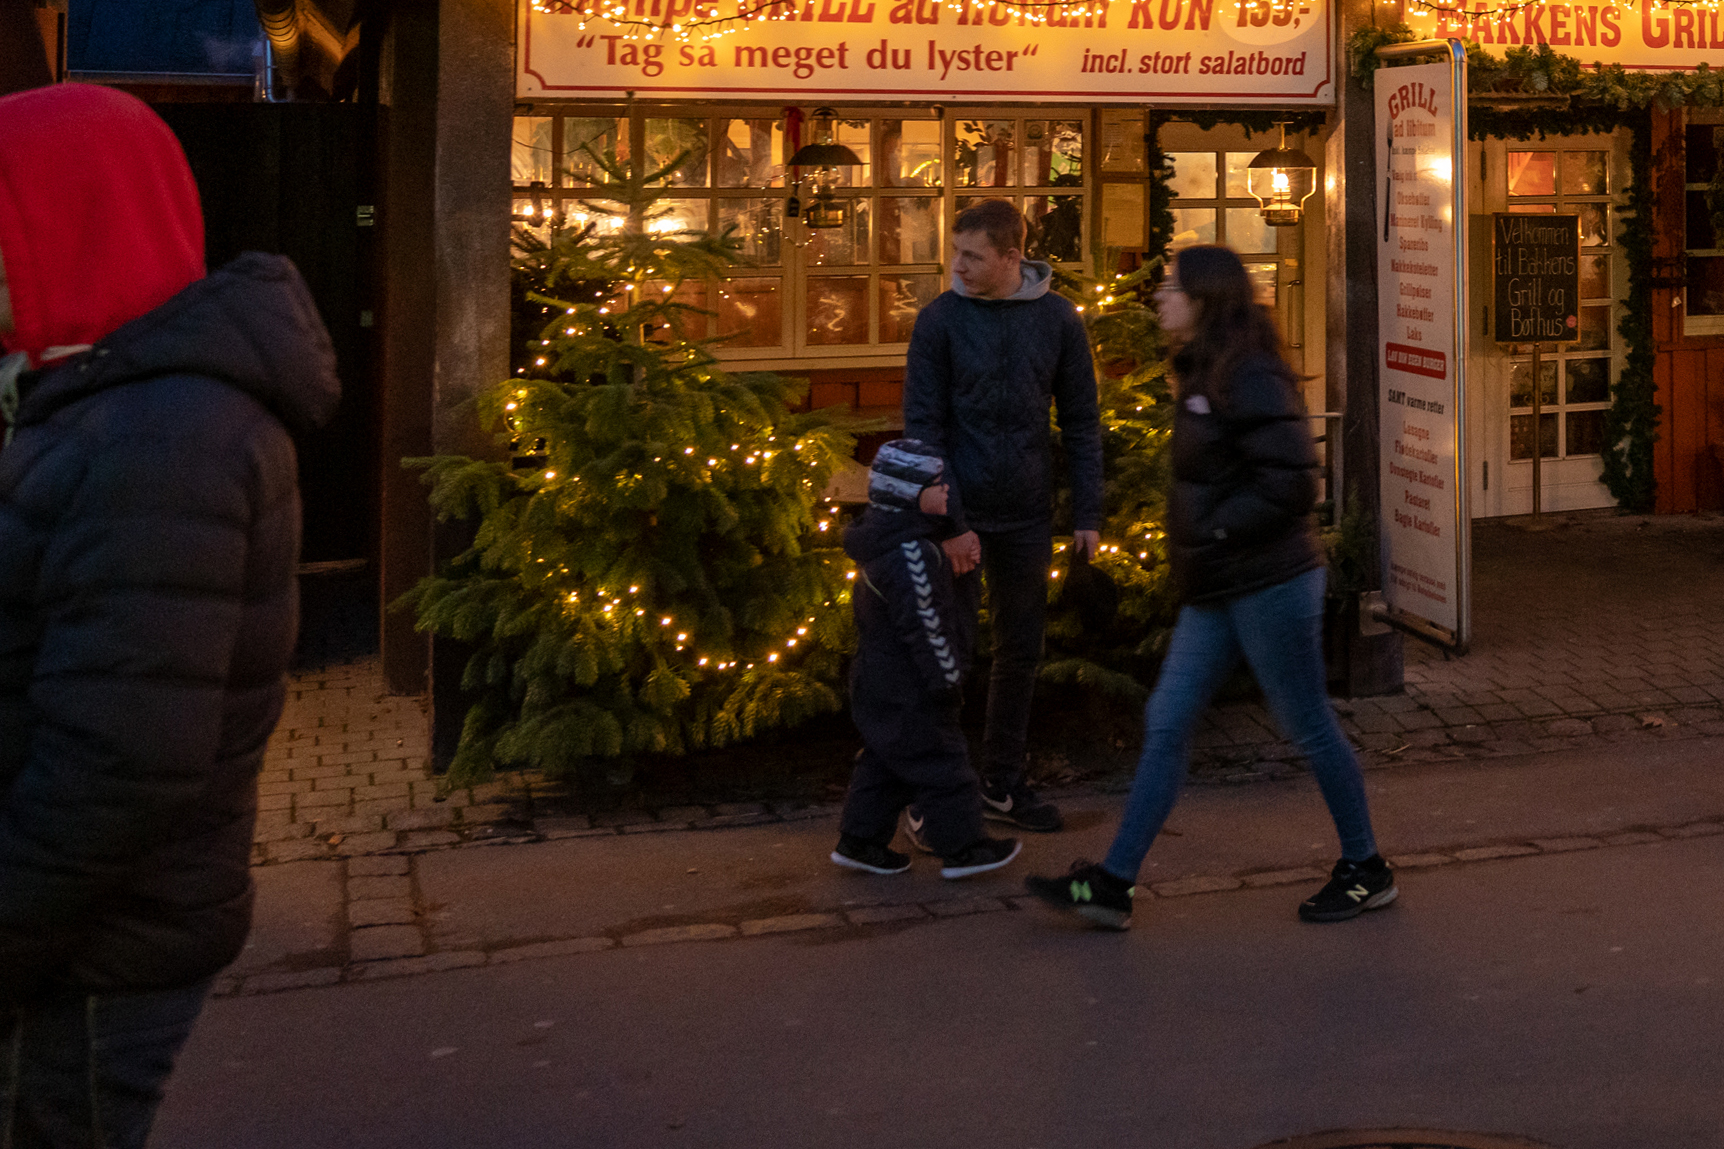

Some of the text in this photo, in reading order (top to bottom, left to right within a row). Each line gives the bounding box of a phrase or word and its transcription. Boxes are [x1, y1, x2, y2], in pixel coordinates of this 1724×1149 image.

[734, 41, 849, 80] meget
[865, 39, 912, 70] du
[1081, 48, 1307, 77] incl. stort salatbord
[1388, 82, 1438, 120] GRILL
[1500, 218, 1569, 245] Velkommen
[1496, 248, 1575, 276] til Bakkens
[1508, 278, 1565, 314] Grill og
[1511, 310, 1564, 337] Bøfhus
